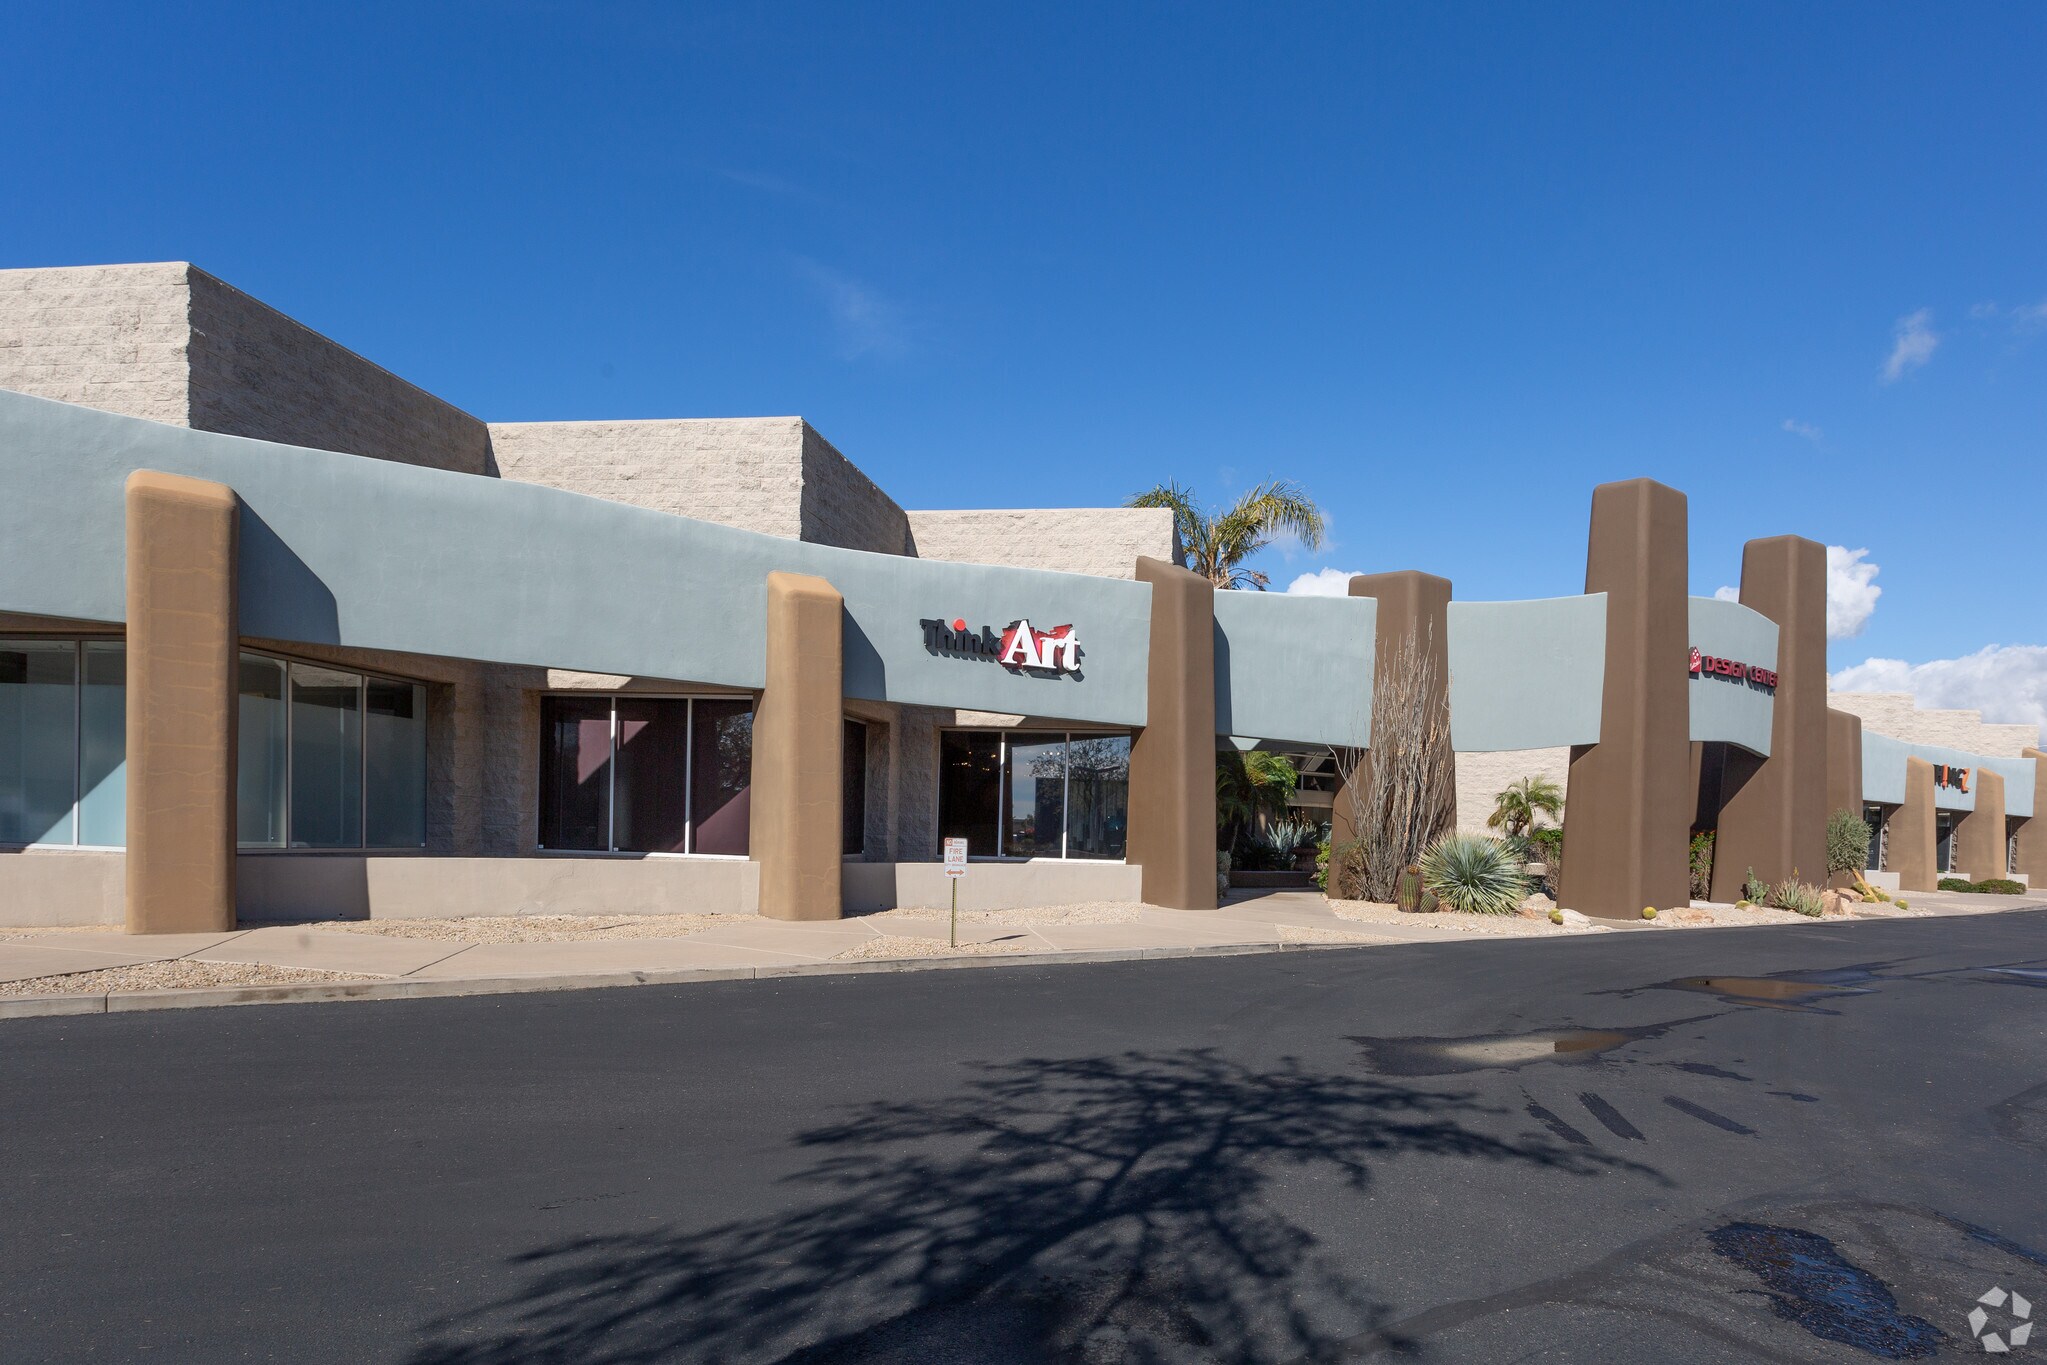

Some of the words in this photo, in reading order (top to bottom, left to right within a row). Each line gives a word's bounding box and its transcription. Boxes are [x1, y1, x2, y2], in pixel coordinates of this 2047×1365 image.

[920, 618, 1001, 655] Think
[1001, 620, 1080, 671] Art
[1703, 656, 1747, 678] DESIGN
[1750, 666, 1778, 687] CENTER
